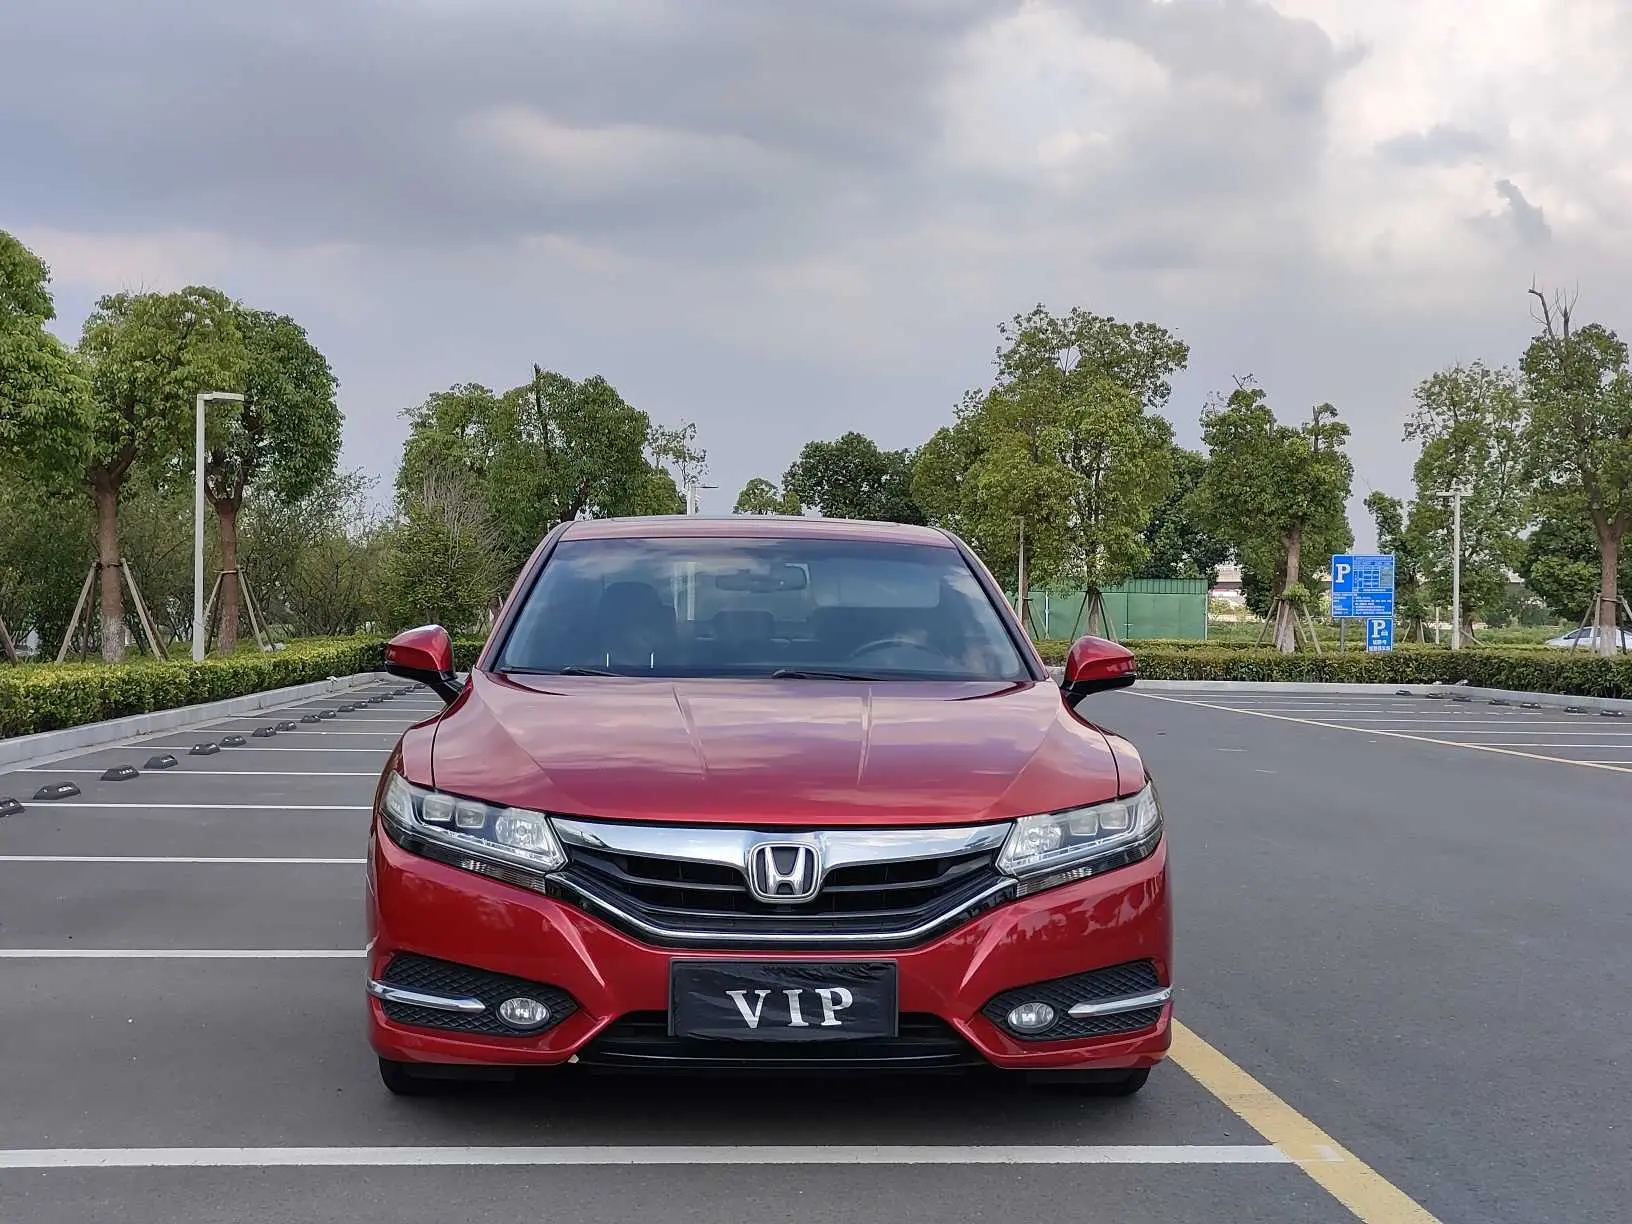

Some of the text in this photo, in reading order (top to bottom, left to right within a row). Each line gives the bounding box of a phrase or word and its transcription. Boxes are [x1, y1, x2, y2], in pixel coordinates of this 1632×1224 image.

[1335, 563, 1351, 583] P
[1371, 619, 1386, 638] P
[725, 987, 853, 1029] VIP
